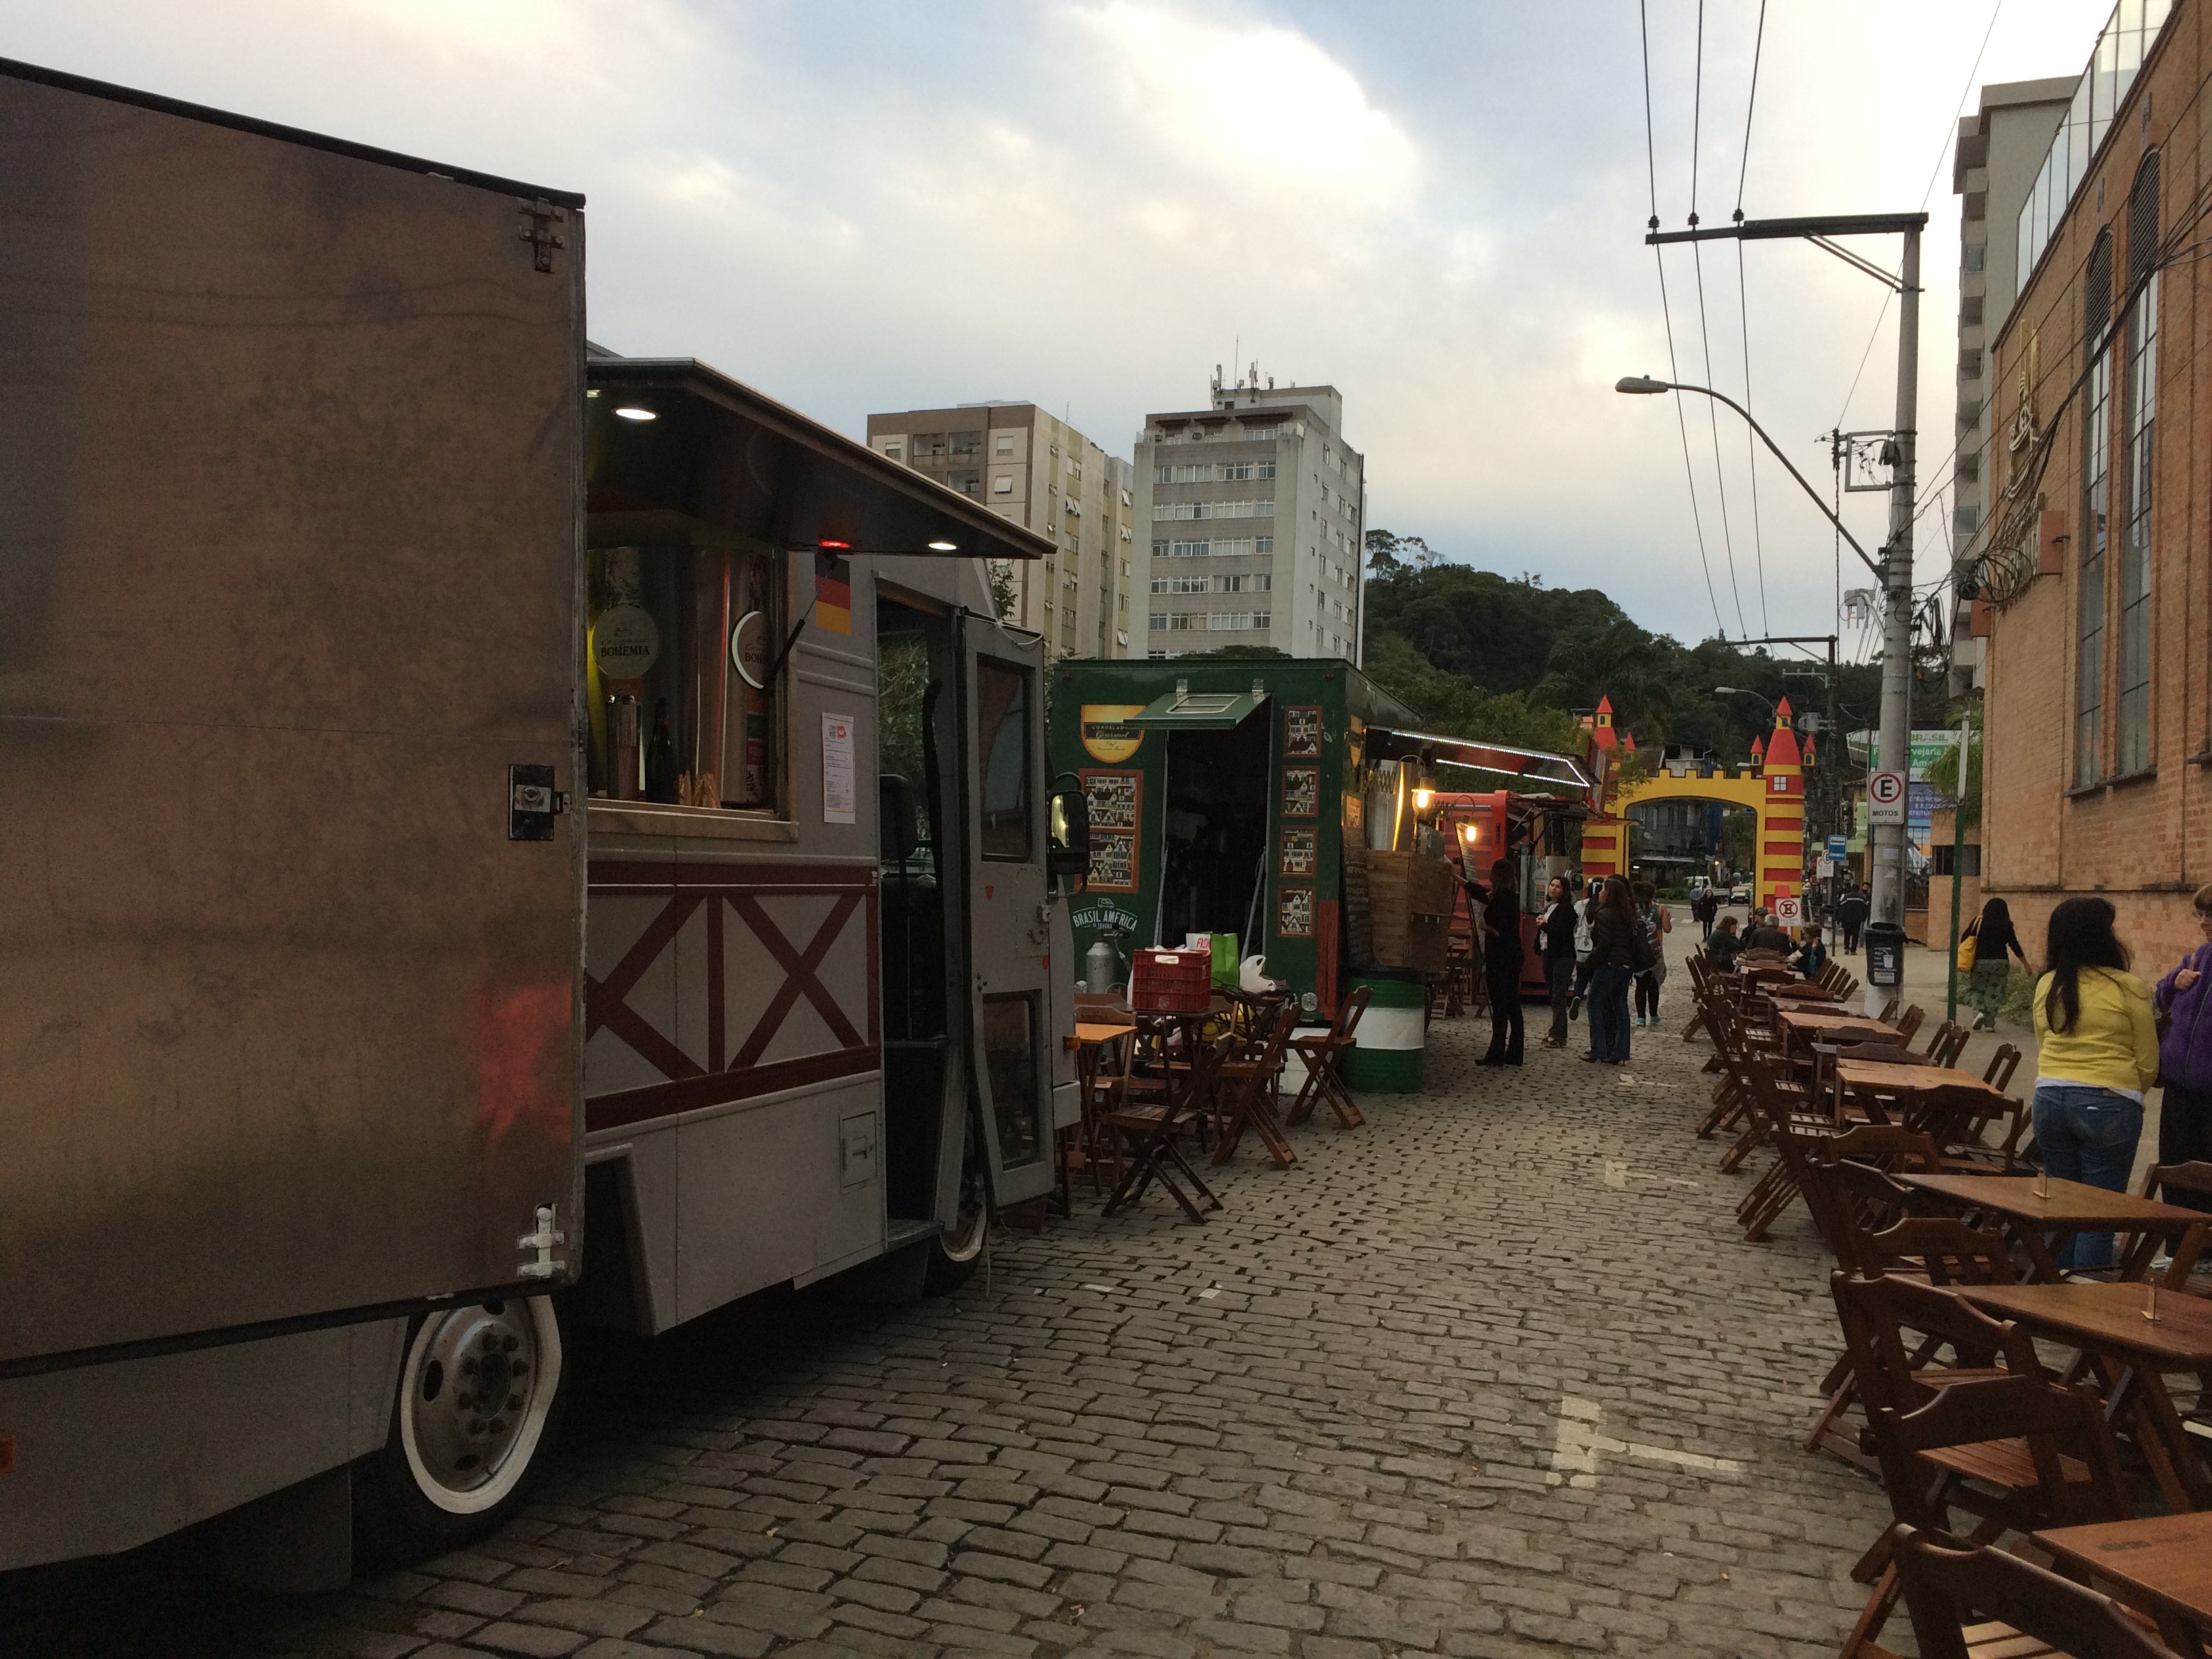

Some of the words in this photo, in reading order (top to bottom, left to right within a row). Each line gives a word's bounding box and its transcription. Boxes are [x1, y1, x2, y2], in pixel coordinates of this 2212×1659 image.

[600, 645, 651, 657] BOHEMIA
[1880, 779, 1893, 797] E
[1073, 909, 1101, 928] BRASIL
